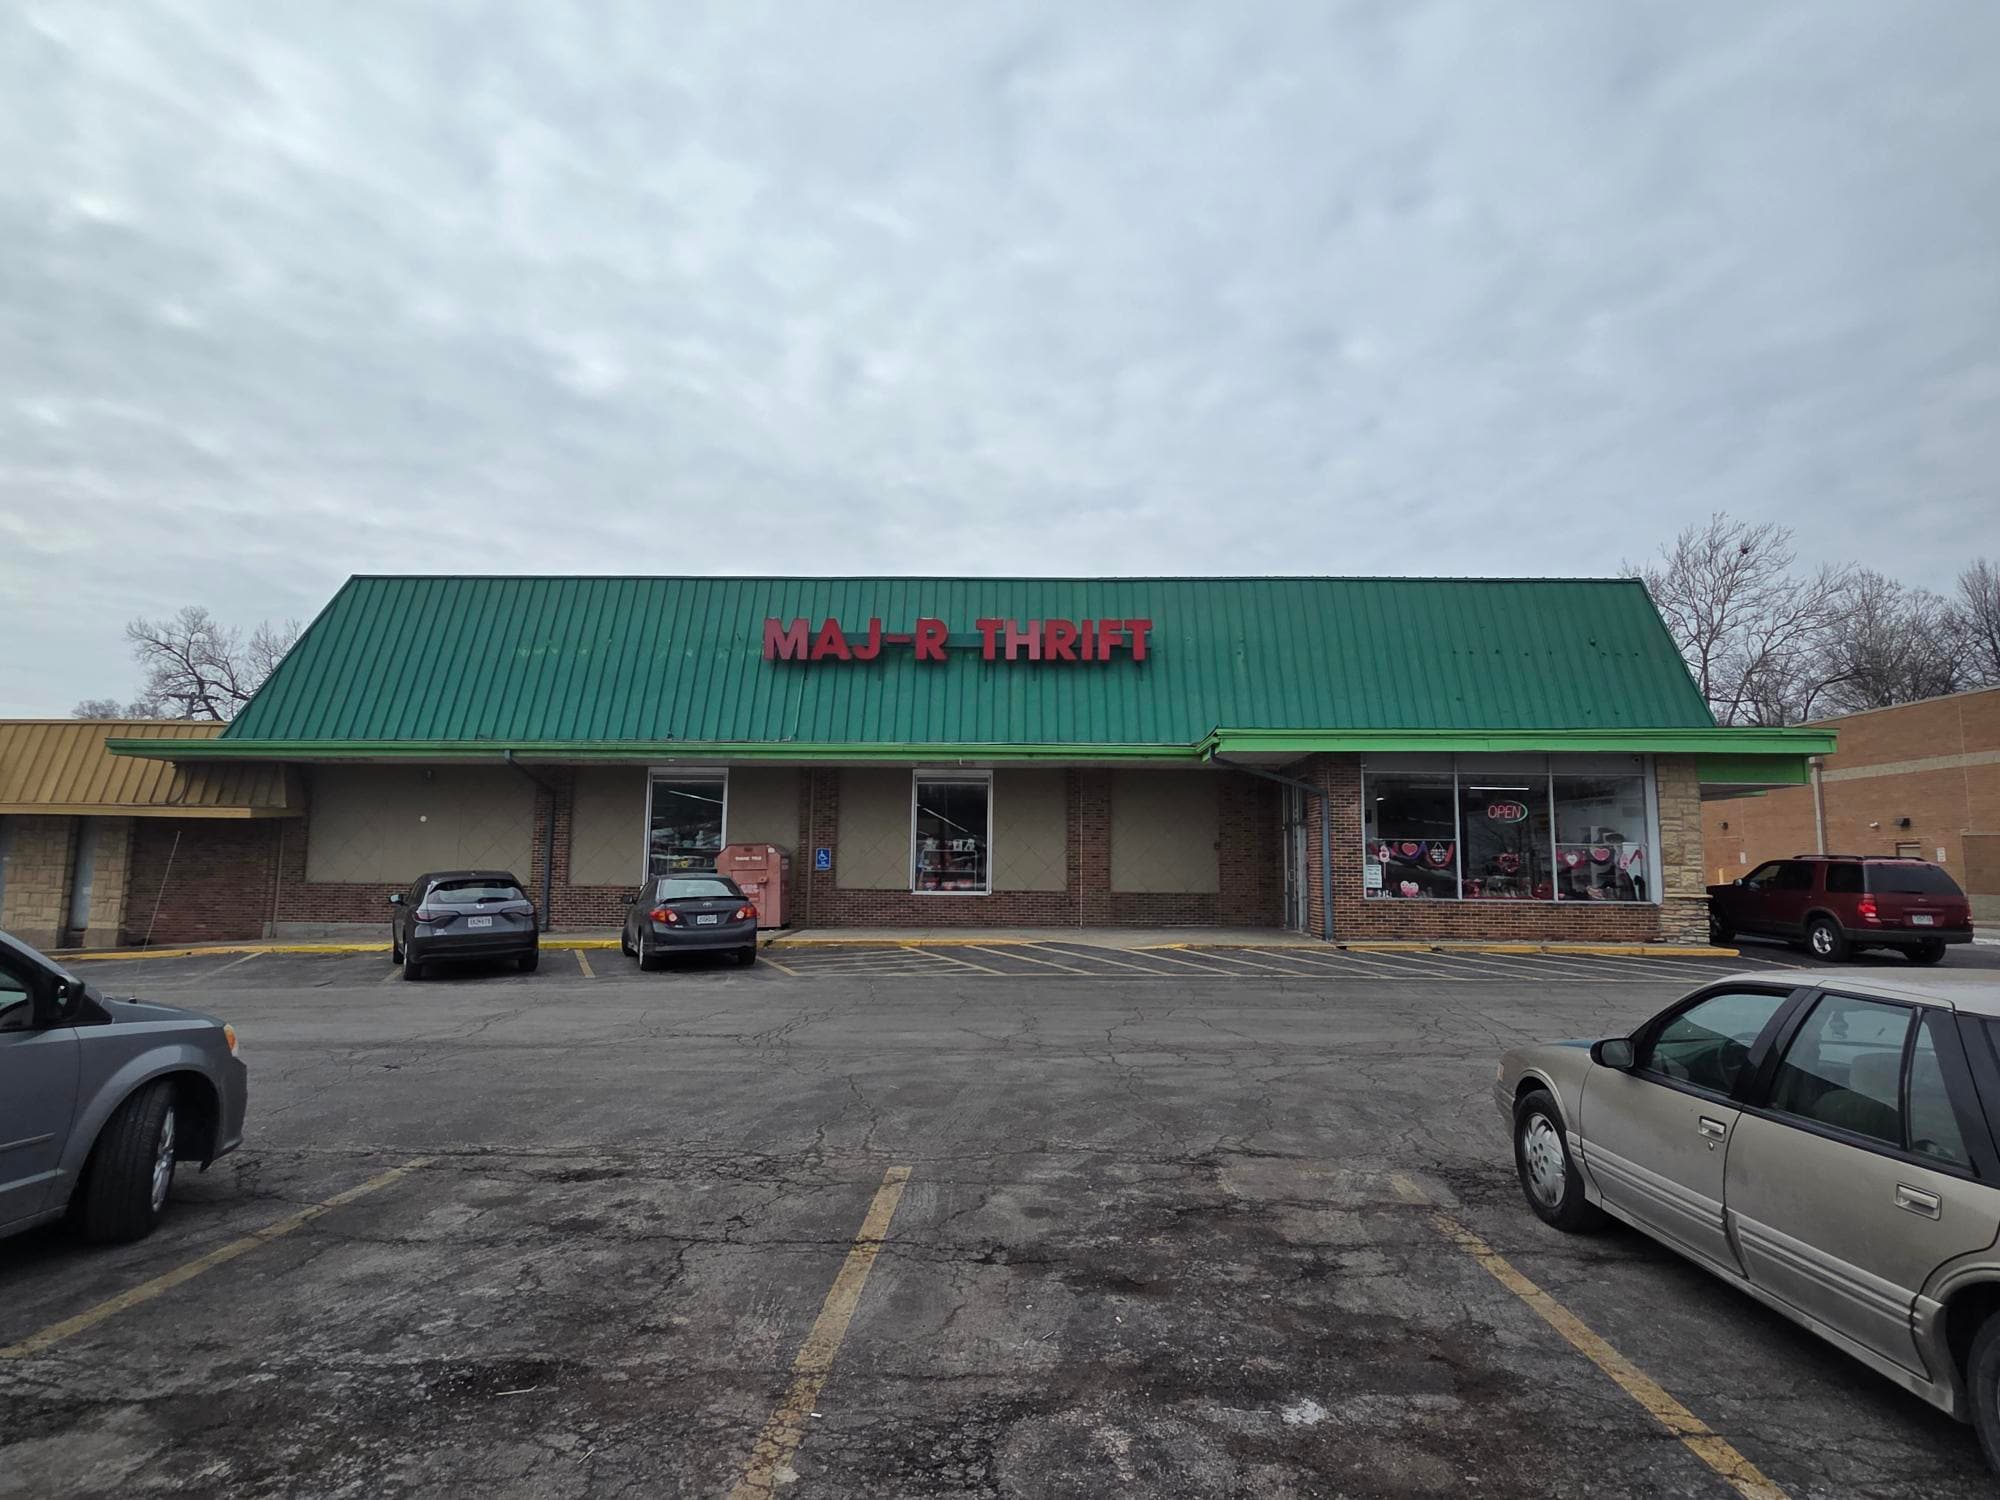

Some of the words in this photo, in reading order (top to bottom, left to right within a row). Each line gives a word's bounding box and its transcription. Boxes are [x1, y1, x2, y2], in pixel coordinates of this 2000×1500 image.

[764, 618, 949, 661] MAJ-R
[976, 618, 1153, 661] THRIFT
[1488, 804, 1522, 819] OPEN
